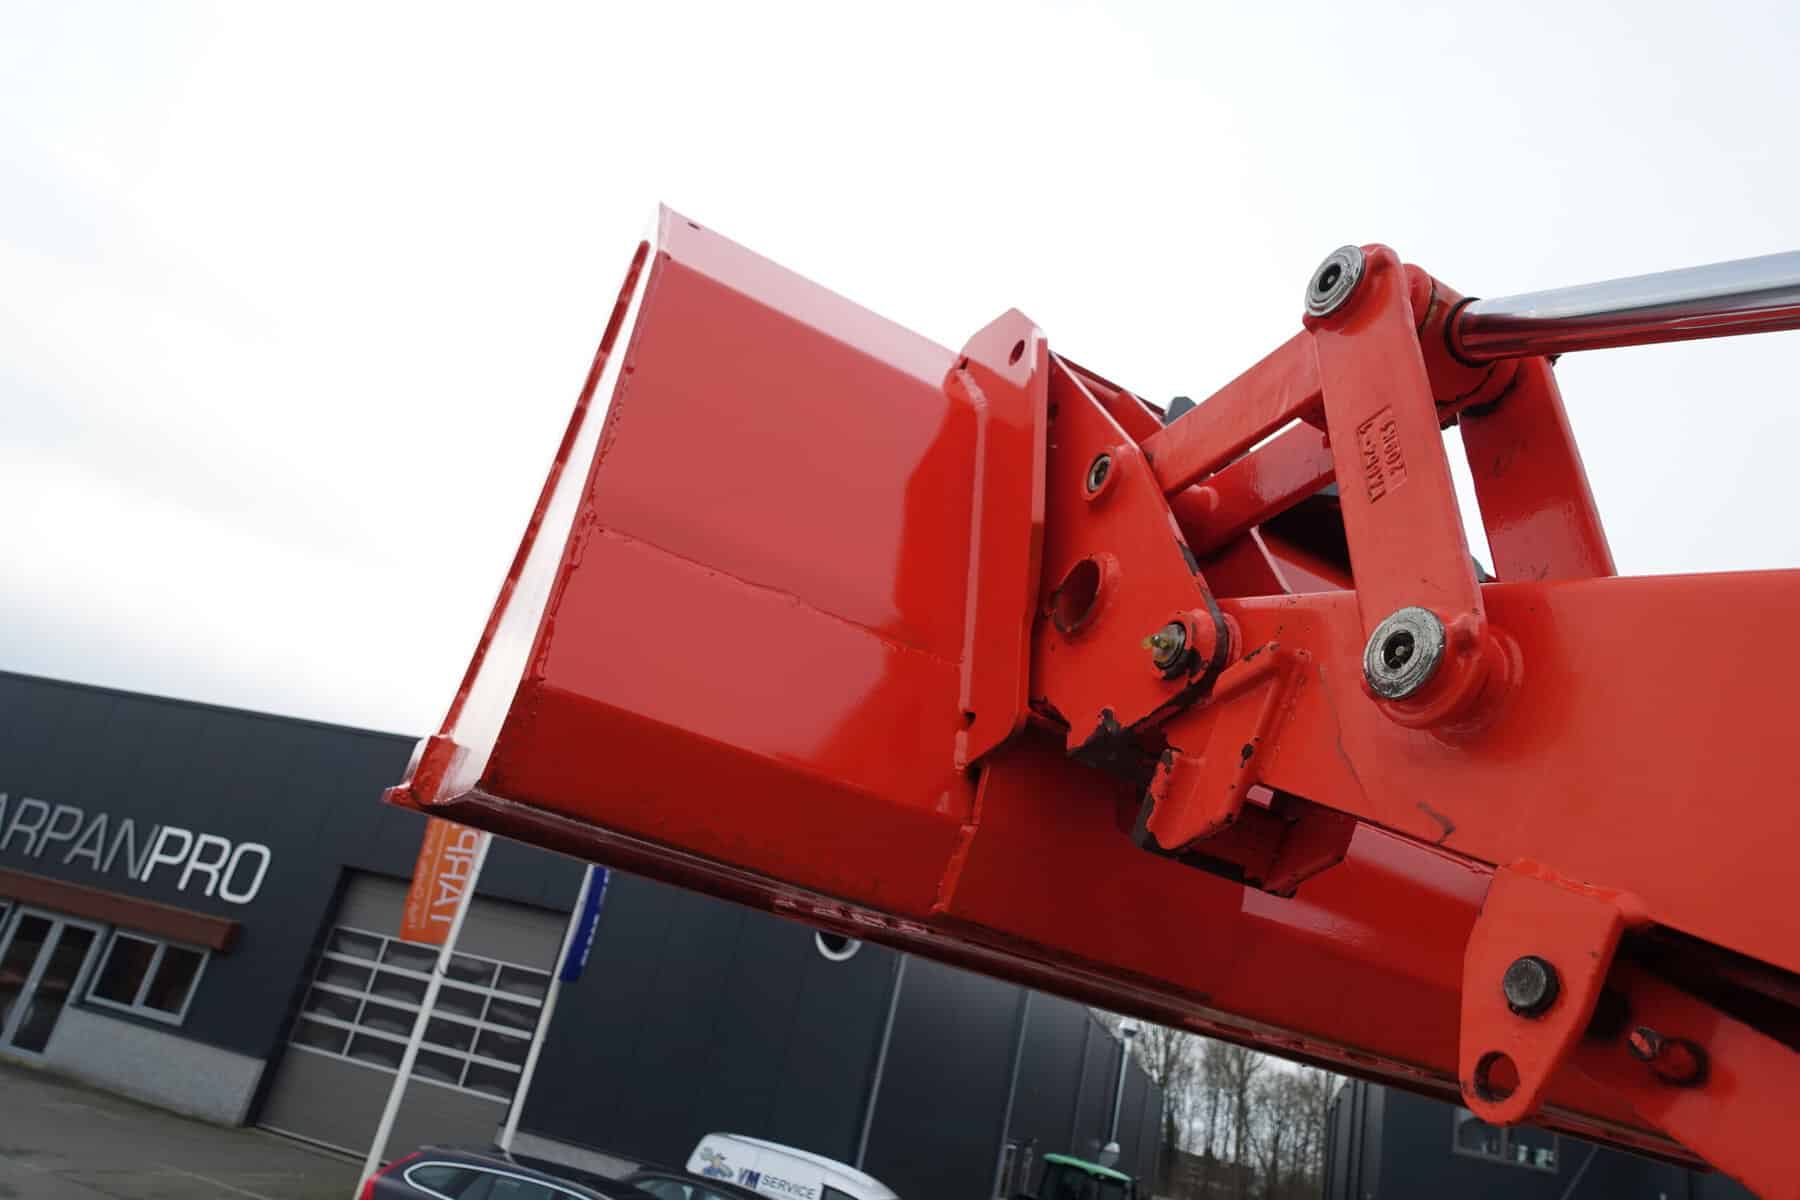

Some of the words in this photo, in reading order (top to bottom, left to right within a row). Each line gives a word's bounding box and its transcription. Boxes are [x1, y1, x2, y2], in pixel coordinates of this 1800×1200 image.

[0, 792, 272, 905] RPANPRO
[738, 1167, 762, 1189] VM
[761, 1174, 816, 1200] SERVICE
